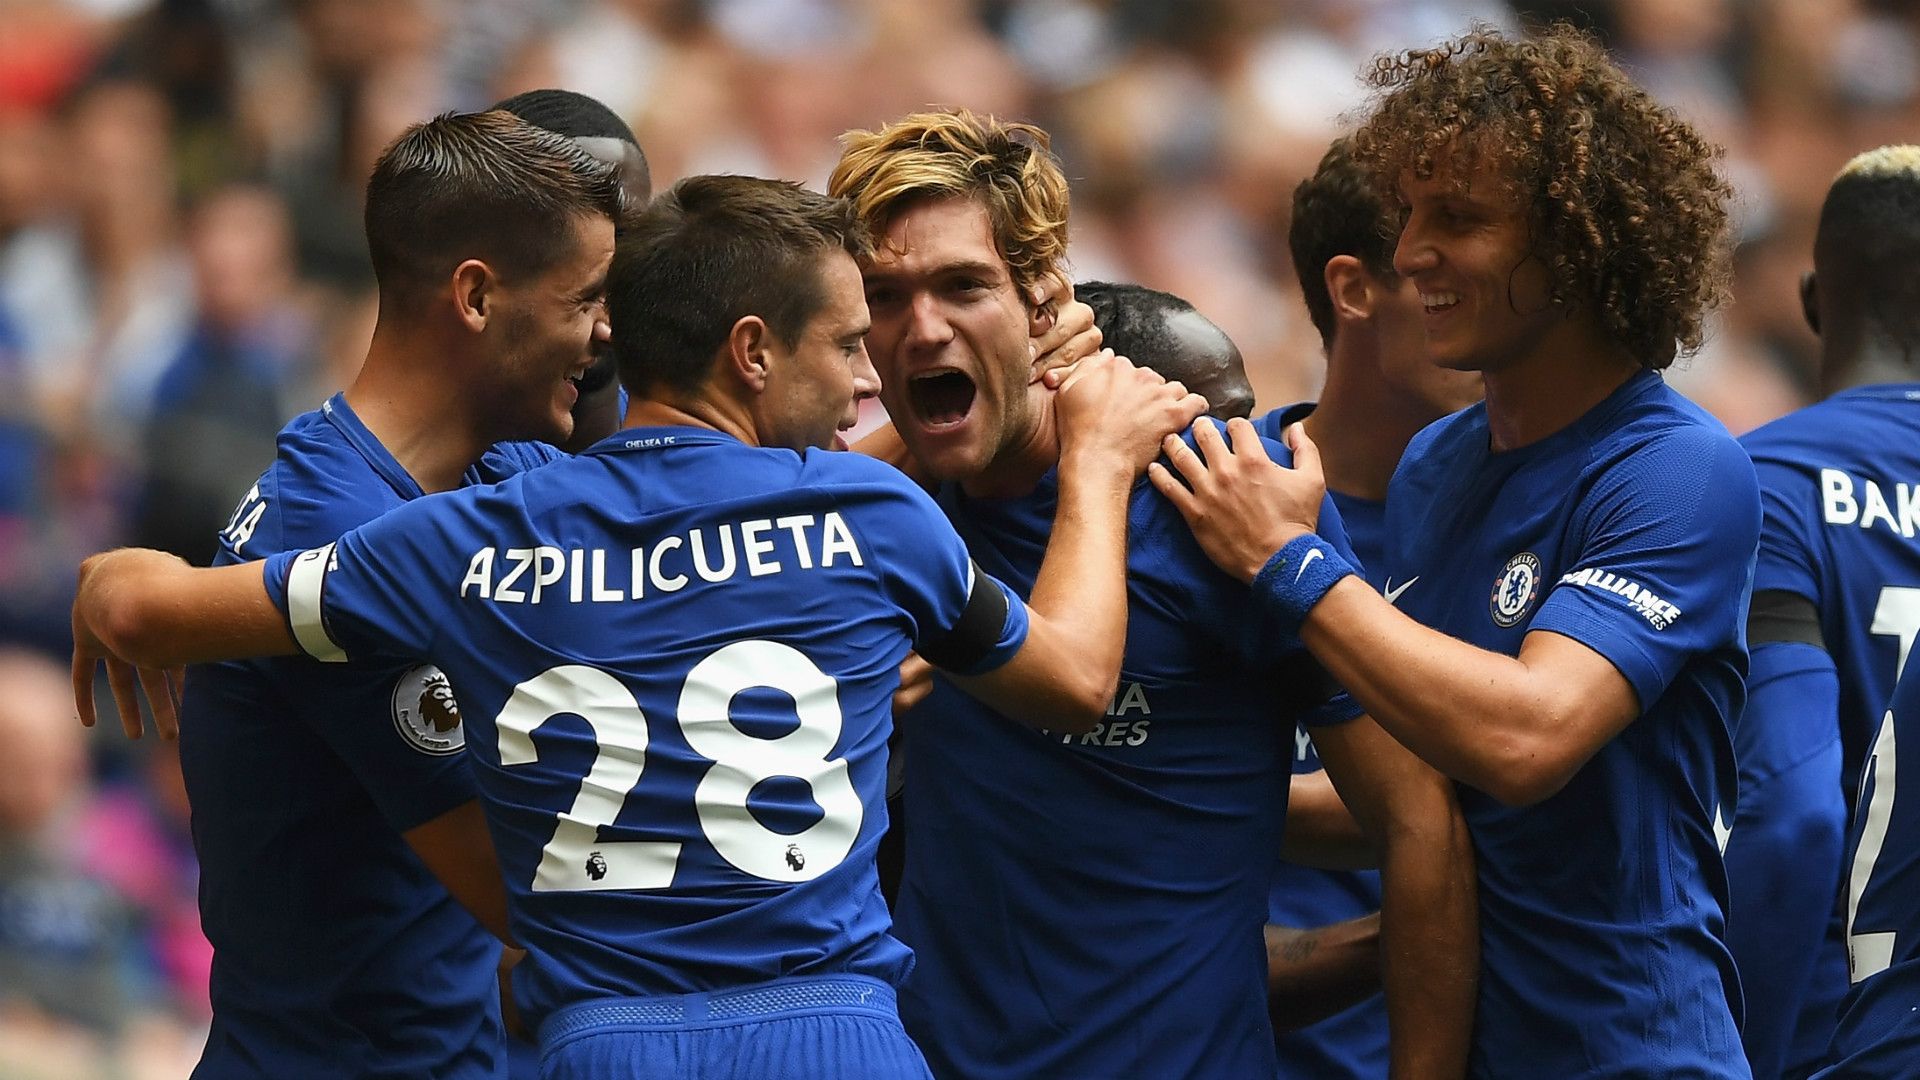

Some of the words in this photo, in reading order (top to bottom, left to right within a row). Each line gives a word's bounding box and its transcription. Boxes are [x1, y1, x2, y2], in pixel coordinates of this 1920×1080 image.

[625, 438, 661, 448] CHELSEA
[664, 436, 675, 444] FC
[460, 511, 864, 604] AZPILICUETA
[1506, 554, 1538, 571] CHELSEA
[1570, 568, 1681, 624] ALLIANCE
[1627, 599, 1666, 631] TYRES
[495, 639, 864, 892] 28
